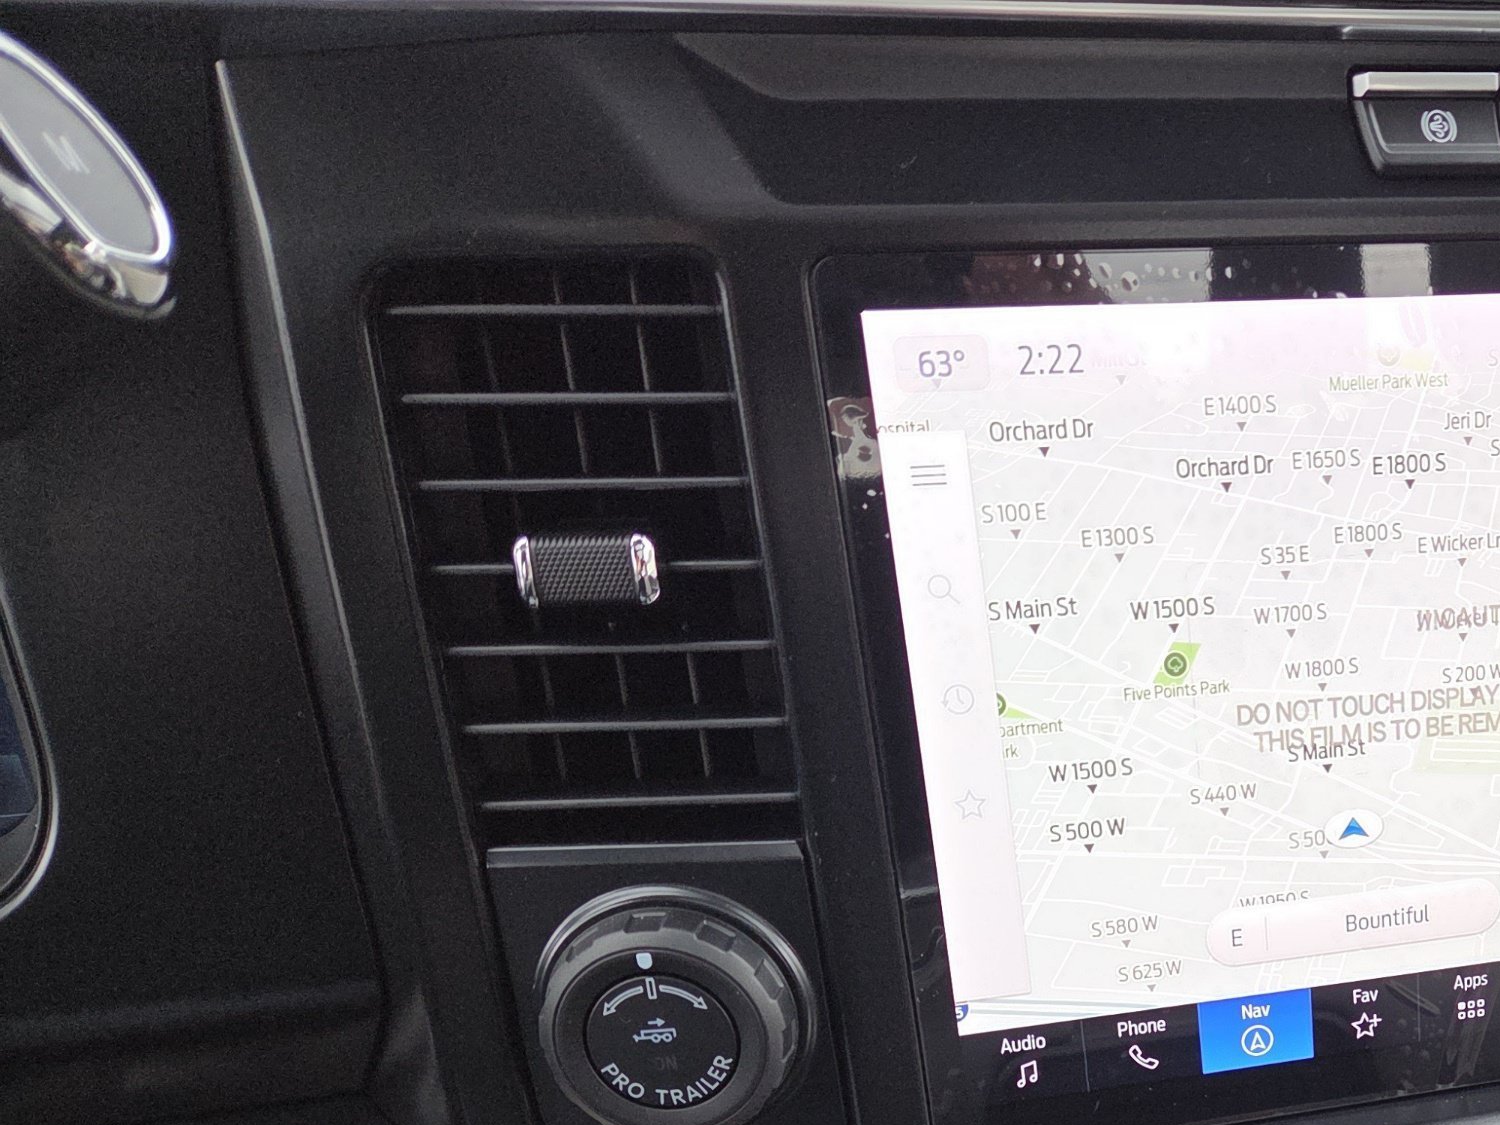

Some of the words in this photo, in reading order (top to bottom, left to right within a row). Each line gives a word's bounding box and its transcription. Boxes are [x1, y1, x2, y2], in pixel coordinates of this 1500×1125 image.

[1018, 344, 1085, 375] 2:22
[1329, 376, 1379, 392] Mueller
[1382, 375, 1412, 389] Park
[1416, 373, 1448, 388] West
[1205, 398, 1215, 415] E
[1218, 396, 1260, 414] 1400
[1265, 396, 1276, 413] S
[989, 420, 1066, 442] Orchard
[1073, 420, 1093, 439] Dr
[1444, 413, 1470, 431] Jeri
[1475, 412, 1491, 428] Dr
[1491, 439, 1500, 457] S
[1176, 455, 1249, 478] Orchard
[1254, 456, 1273, 474] Dr
[1293, 452, 1303, 470] E
[1307, 450, 1346, 468] 1650
[1349, 449, 1360, 467] S
[1373, 457, 1383, 475] E
[1387, 454, 1431, 474] 1800
[1435, 453, 1446, 471] S
[981, 505, 993, 523] S
[997, 504, 1030, 522] 100
[1036, 503, 1046, 521] E
[1081, 530, 1093, 547] E
[1095, 528, 1138, 546] 1300
[1142, 527, 1154, 544] S
[1418, 537, 1427, 554] E
[1431, 534, 1482, 552] Wicker
[989, 603, 1001, 620] S
[1006, 600, 1051, 620] Main
[1056, 597, 1077, 616] St
[1130, 602, 1150, 620] W
[1154, 598, 1198, 618] 1500
[1204, 597, 1215, 615] S
[1254, 609, 1270, 624] W
[1275, 605, 1313, 622] 1700
[1317, 604, 1327, 619] S
[1285, 663, 1301, 679] W
[1305, 660, 1344, 677] 1800
[1349, 658, 1359, 673] S
[1443, 668, 1452, 683] S
[1456, 665, 1485, 683] 200
[1124, 687, 1151, 701] Five
[1154, 683, 1197, 699] Points
[1200, 681, 1230, 695] Park
[1237, 703, 1270, 725] DO
[1276, 699, 1323, 722] NOT
[1328, 692, 1404, 718] TOUCH
[1411, 684, 1500, 711] DISPLAY
[1254, 729, 1304, 752] THIS
[1311, 723, 1361, 749] FILM
[1368, 722, 1386, 743] IS
[1391, 718, 1420, 740] TO
[1427, 715, 1454, 737] BE
[1288, 745, 1299, 762] S
[1304, 743, 1344, 761] Main
[1348, 740, 1365, 756] St
[1049, 765, 1067, 783] W
[1072, 761, 1116, 780] 1500
[1121, 758, 1133, 776] S
[1190, 789, 1200, 805] S
[1205, 786, 1237, 803] 440
[1240, 783, 1257, 799] W
[1050, 825, 1061, 842] S
[1065, 821, 1102, 840] 500
[1106, 818, 1125, 836] W
[1091, 922, 1102, 938] S
[1106, 918, 1138, 936] 580
[1142, 915, 1158, 931] W
[1346, 905, 1429, 932] Bountiful
[1231, 928, 1243, 947] E
[1453, 973, 1488, 991] Apps
[1352, 989, 1379, 1004] Fav
[1241, 1004, 1271, 1019] Nav
[1117, 1017, 1166, 1038] Phone
[1000, 1034, 1046, 1055] Audio
[600, 1063, 645, 1099] PRO
[655, 1055, 733, 1105] TRAILER
